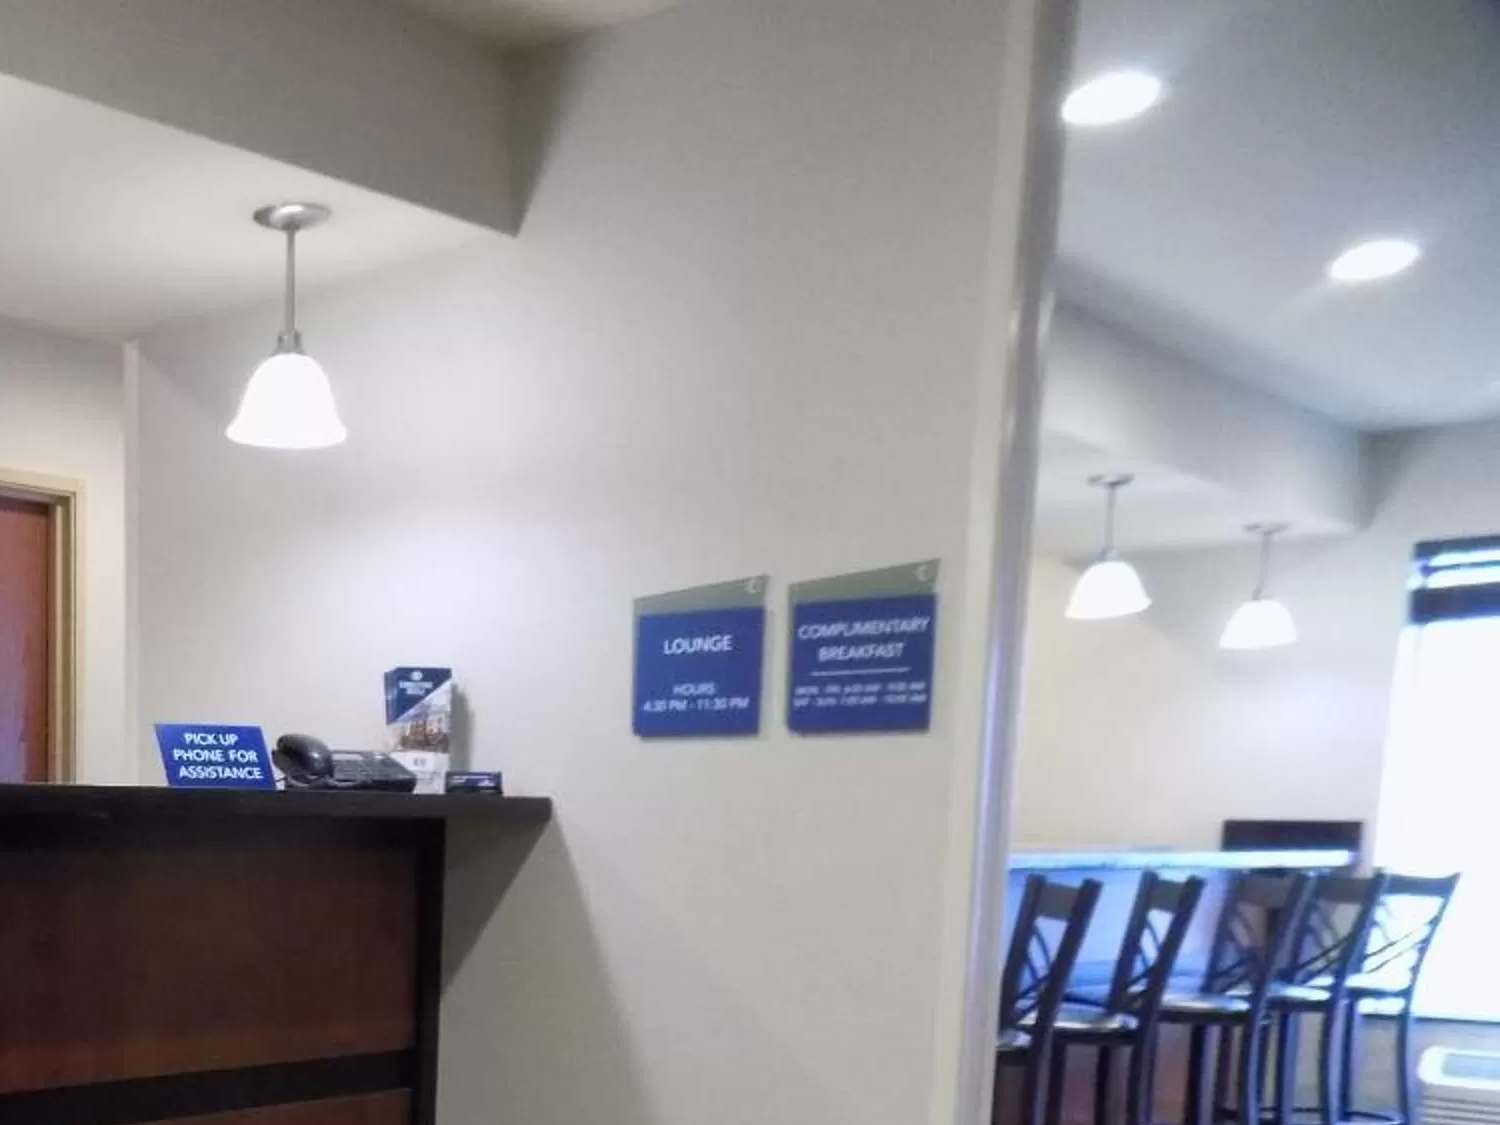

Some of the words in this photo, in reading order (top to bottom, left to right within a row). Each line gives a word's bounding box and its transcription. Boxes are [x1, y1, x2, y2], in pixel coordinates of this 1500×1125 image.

[797, 616, 931, 640] COMPLIMENTARY
[663, 634, 733, 656] LOUNGE
[817, 642, 905, 663] BREAKFAST
[672, 681, 717, 697] HOURS
[183, 732, 218, 745] PICK
[219, 733, 239, 746] UP
[173, 748, 225, 762] PHONE
[228, 749, 259, 763] FOR
[179, 765, 265, 780] ASSISTANCE
